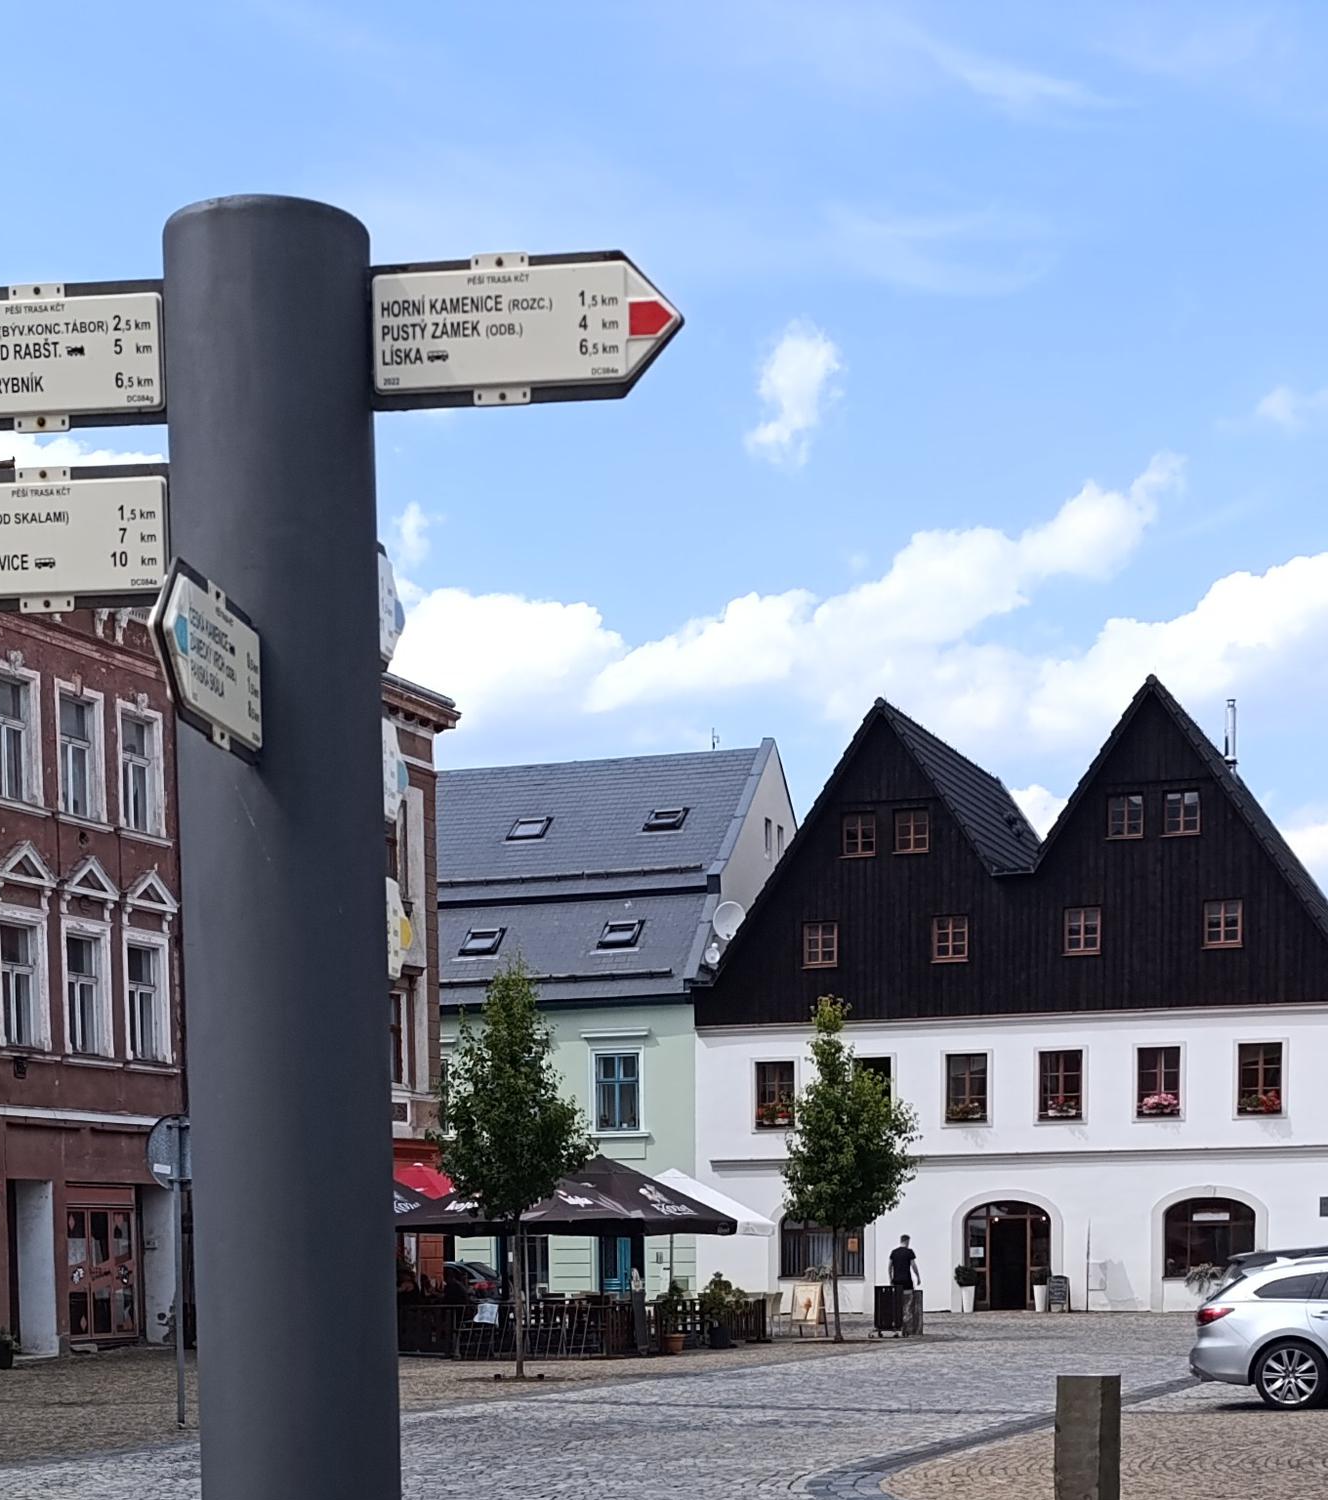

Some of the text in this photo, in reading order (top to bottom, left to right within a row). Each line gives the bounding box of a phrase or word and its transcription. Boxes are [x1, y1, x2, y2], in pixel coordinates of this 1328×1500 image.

[486, 275, 512, 284] TRASA
[23, 305, 49, 314] TRASA
[381, 295, 425, 318] HORNÍ
[429, 295, 503, 316] KAMENICE
[507, 298, 553, 313] (ROZC.)
[601, 294, 618, 306] km
[135, 319, 151, 331] km
[382, 315, 619, 342] PUSTÝ ZÁMEK (ODB.) 4 km
[14, 340, 61, 360] RABŠT.
[114, 339, 123, 355] 5
[136, 343, 152, 355] km
[382, 343, 423, 366] LÍSKA
[602, 343, 619, 354] km
[137, 376, 153, 388] km
[30, 488, 55, 497] TRASA
[14, 511, 69, 526] SKALAMI)
[140, 508, 156, 520] km
[118, 527, 127, 544] 7
[140, 532, 156, 543] km
[110, 551, 128, 568] 10
[141, 555, 157, 566] km
